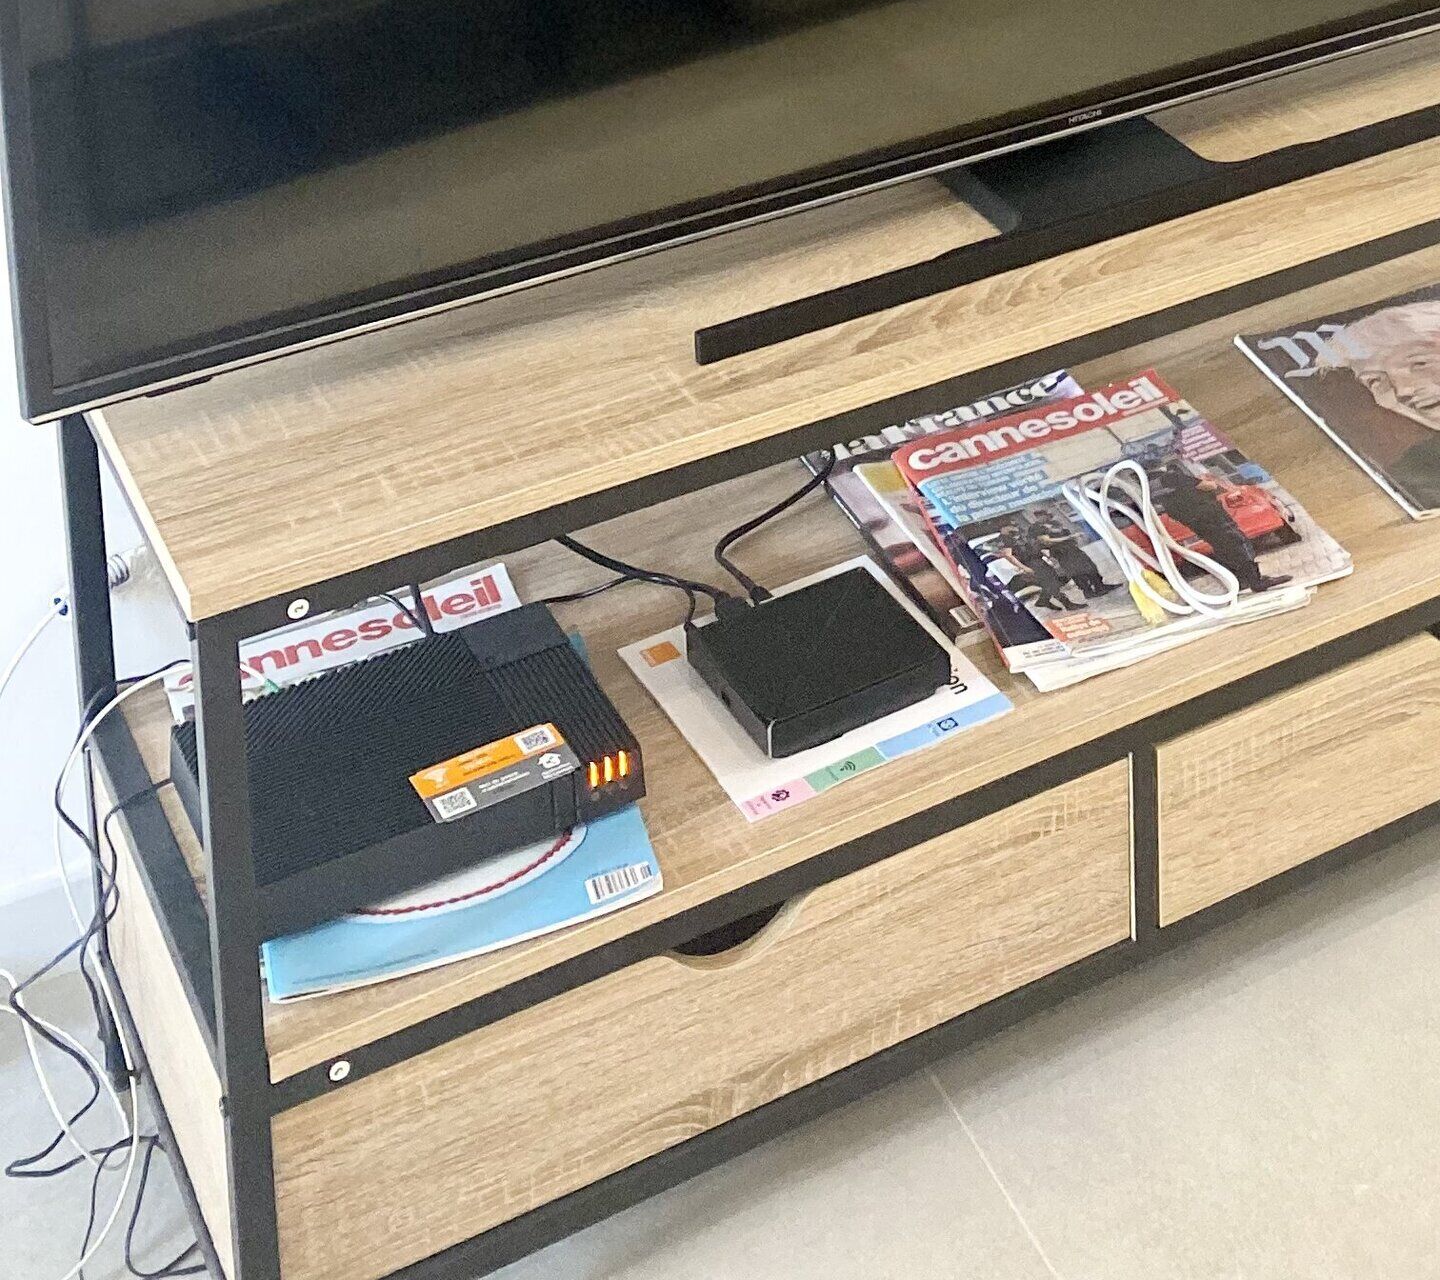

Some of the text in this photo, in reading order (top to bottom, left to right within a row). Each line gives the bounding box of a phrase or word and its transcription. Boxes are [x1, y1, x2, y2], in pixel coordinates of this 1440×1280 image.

[1068, 109, 1102, 124] HITACHI
[908, 376, 1166, 470] cannesoleil
[179, 575, 502, 687] nnesoleil
